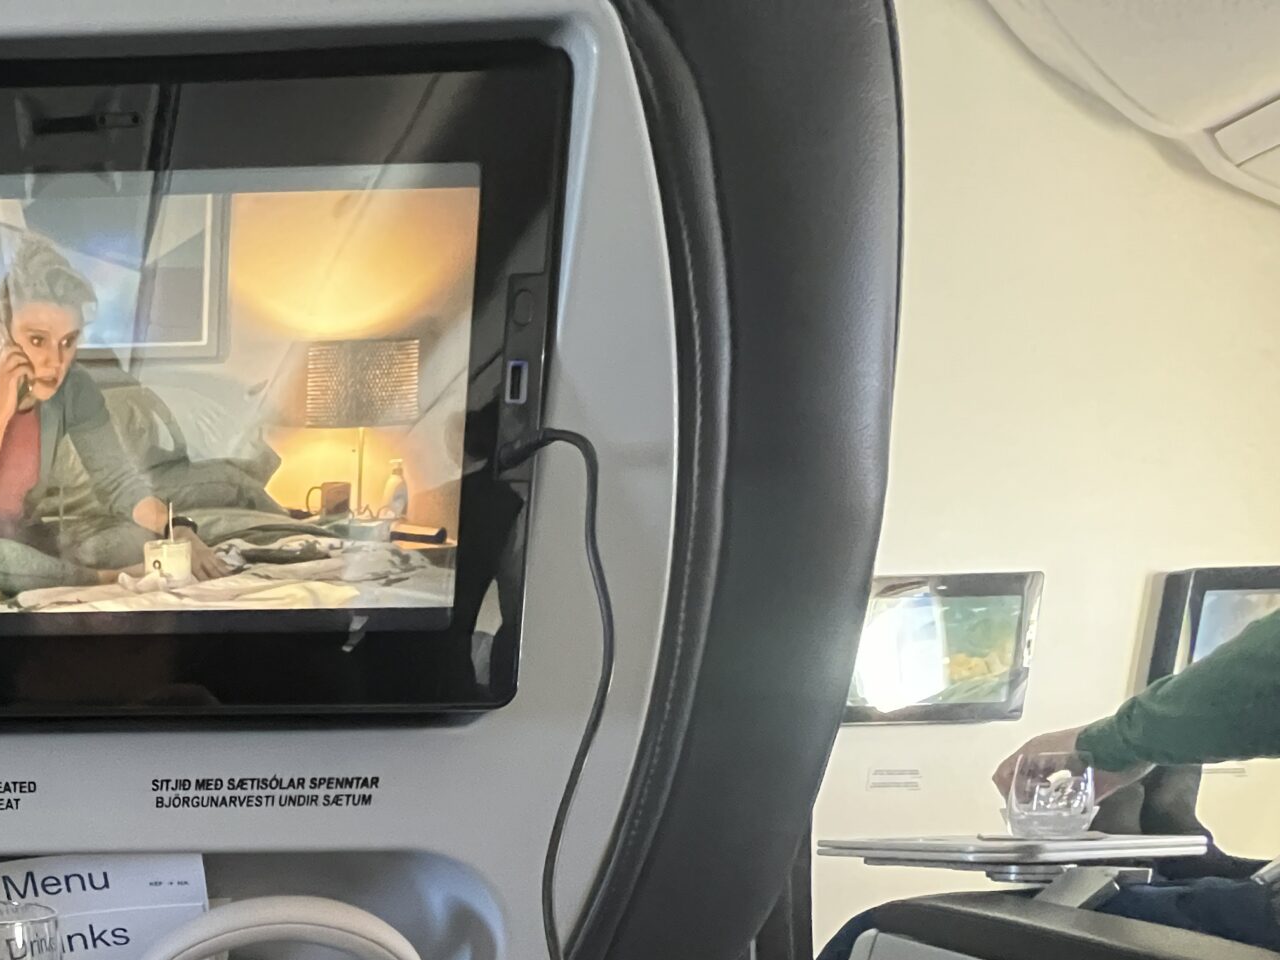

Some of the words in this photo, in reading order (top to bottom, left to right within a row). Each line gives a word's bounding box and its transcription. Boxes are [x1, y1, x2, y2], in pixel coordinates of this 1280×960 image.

[151, 778, 192, 792] SITJIÐ
[195, 778, 224, 791] MEÐ
[227, 774, 306, 791] SÆTISÓLAR
[309, 776, 380, 790] SPENNTAR
[155, 793, 275, 809] BJÖRGUNARVESTI
[278, 794, 319, 807] UNDIR
[322, 793, 372, 807] SÆTUM
[1, 870, 110, 901] Menu
